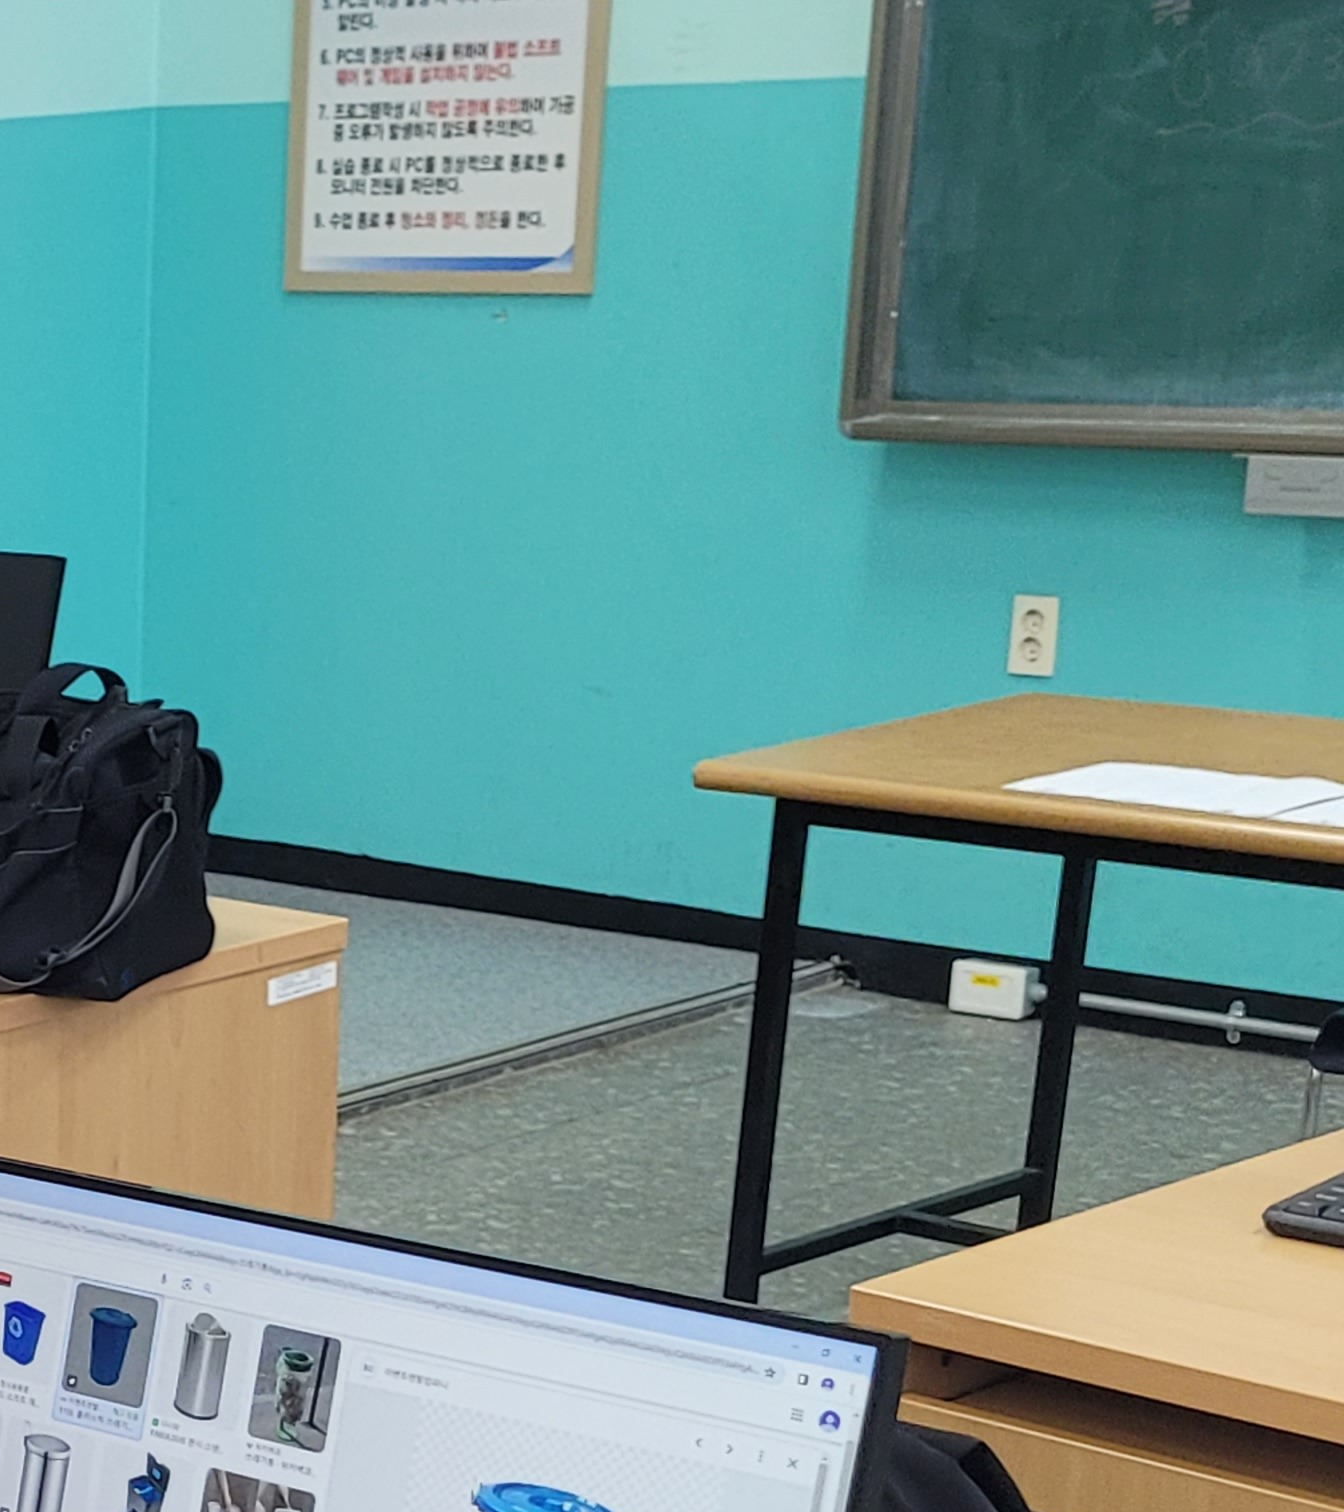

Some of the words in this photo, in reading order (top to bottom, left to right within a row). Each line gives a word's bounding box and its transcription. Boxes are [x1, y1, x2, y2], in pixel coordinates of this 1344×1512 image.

[320, 50, 332, 65] 6.
[336, 48, 366, 64] PC의
[411, 43, 446, 62] 사용을
[453, 42, 489, 60] 위하여
[319, 104, 330, 120] 7.
[409, 100, 421, 118] 시
[349, 122, 384, 140] 오류가
[360, 156, 384, 175] 종료
[389, 156, 401, 174] 시
[405, 155, 435, 174] PC를
[442, 154, 504, 173] 정상적으로
[510, 153, 548, 172] 종료한
[554, 153, 565, 170] 후
[330, 177, 366, 195] 모니터
[370, 177, 405, 195] 전원을
[411, 176, 464, 195] 차단한다.
[330, 212, 353, 229] 수업
[358, 211, 380, 229] 종료
